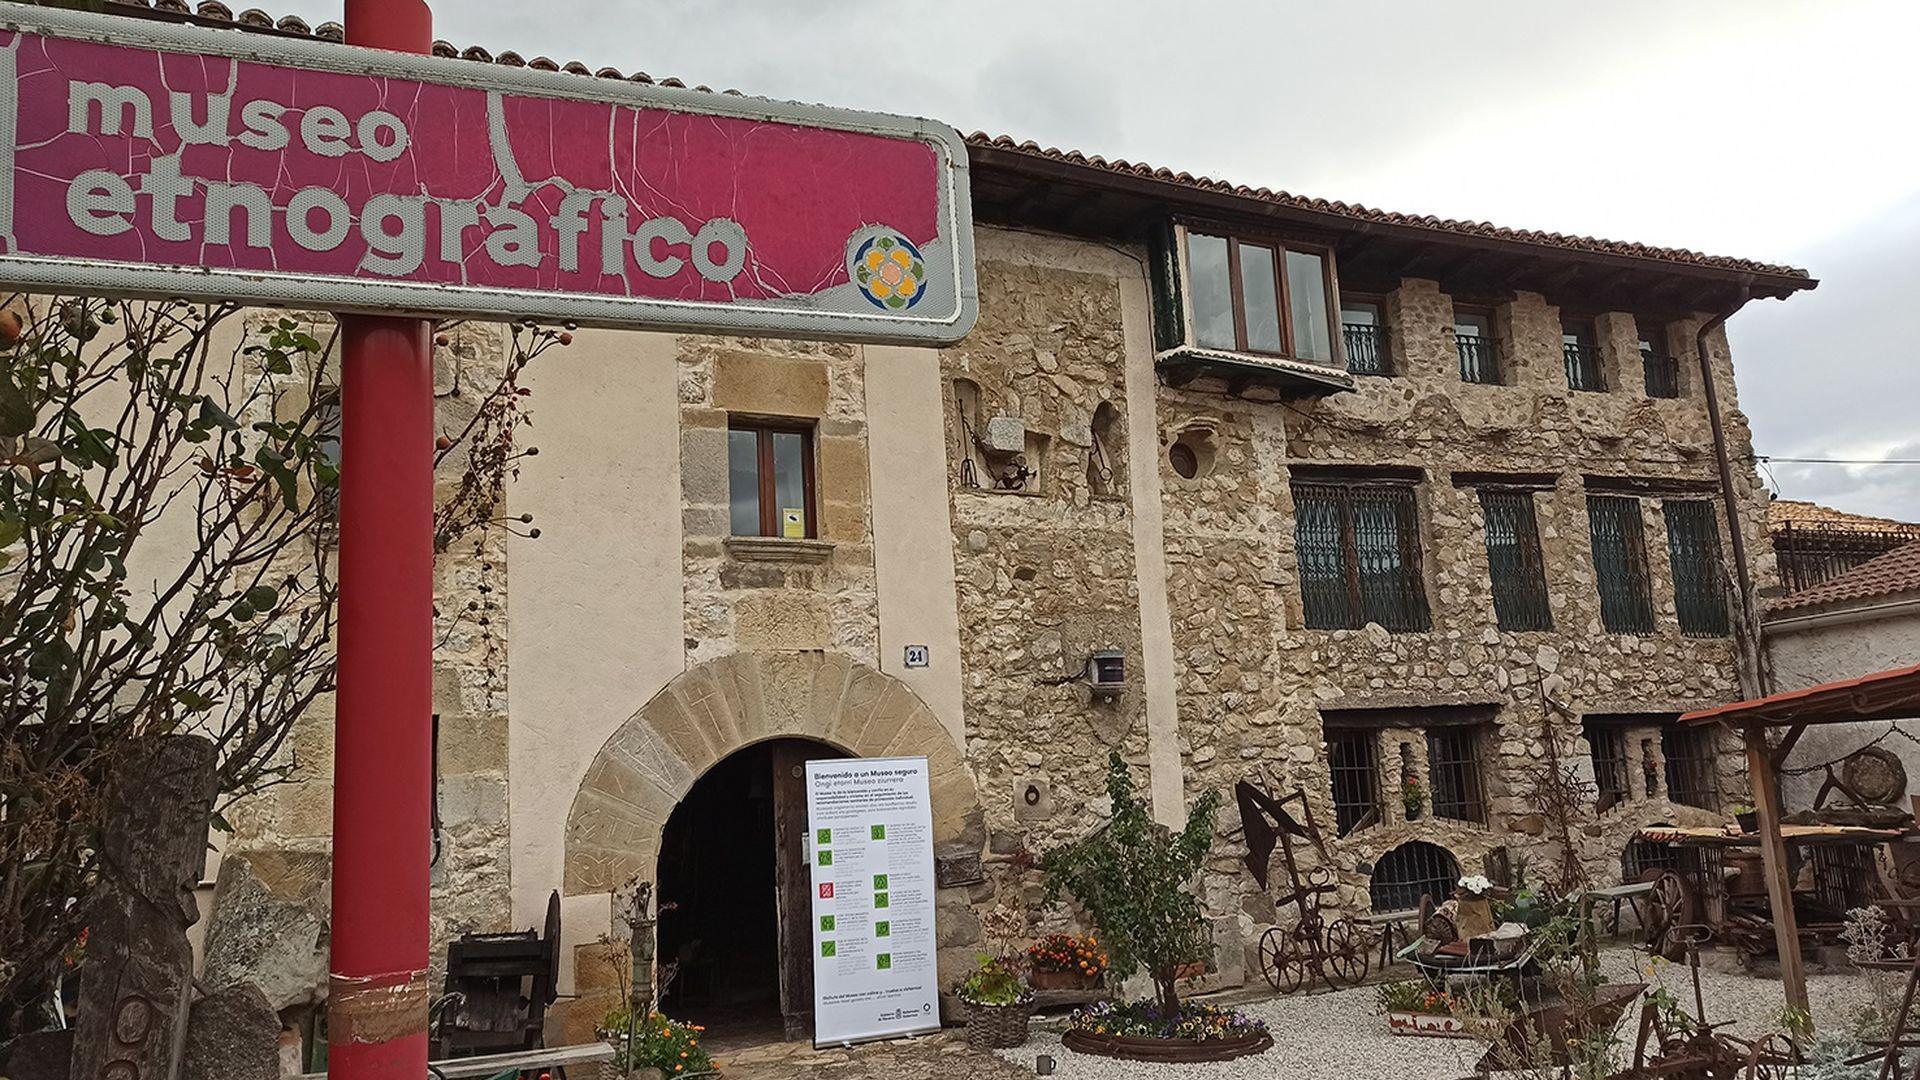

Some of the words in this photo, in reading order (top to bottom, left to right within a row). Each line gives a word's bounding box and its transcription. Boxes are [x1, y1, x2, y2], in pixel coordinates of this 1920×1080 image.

[68, 79, 409, 162] museo
[65, 153, 747, 283] etnográfico
[814, 771, 853, 780] Bienvenido
[870, 769, 894, 777] Museo
[894, 769, 918, 777] seguro
[814, 780, 832, 789] Ongi
